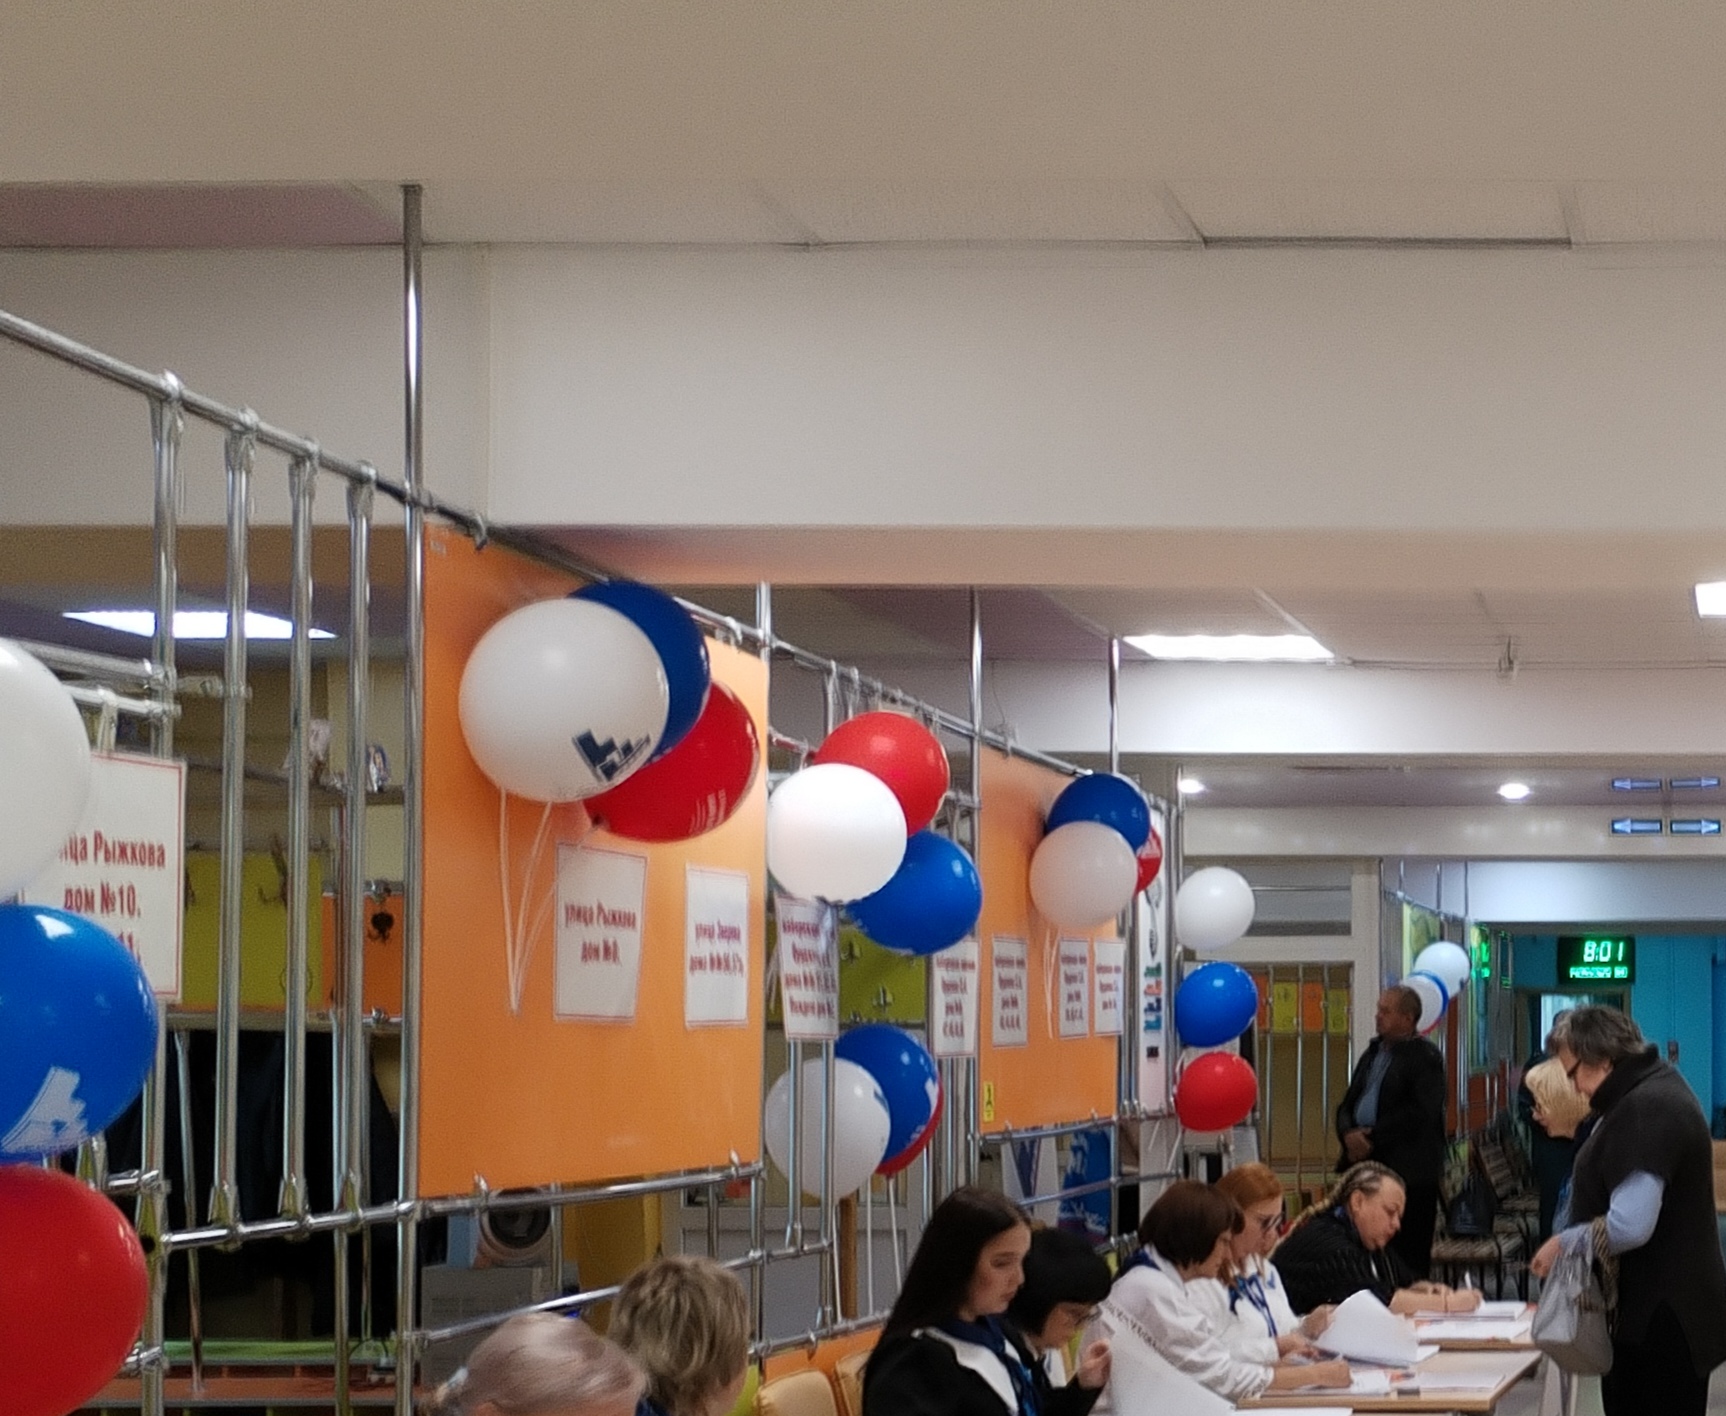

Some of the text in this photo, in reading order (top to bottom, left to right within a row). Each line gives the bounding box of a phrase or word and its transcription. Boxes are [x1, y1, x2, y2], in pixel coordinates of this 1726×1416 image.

[93, 830, 166, 869] Рыжкова
[64, 884, 95, 913] дом
[1583, 941, 1624, 962] 8:01
